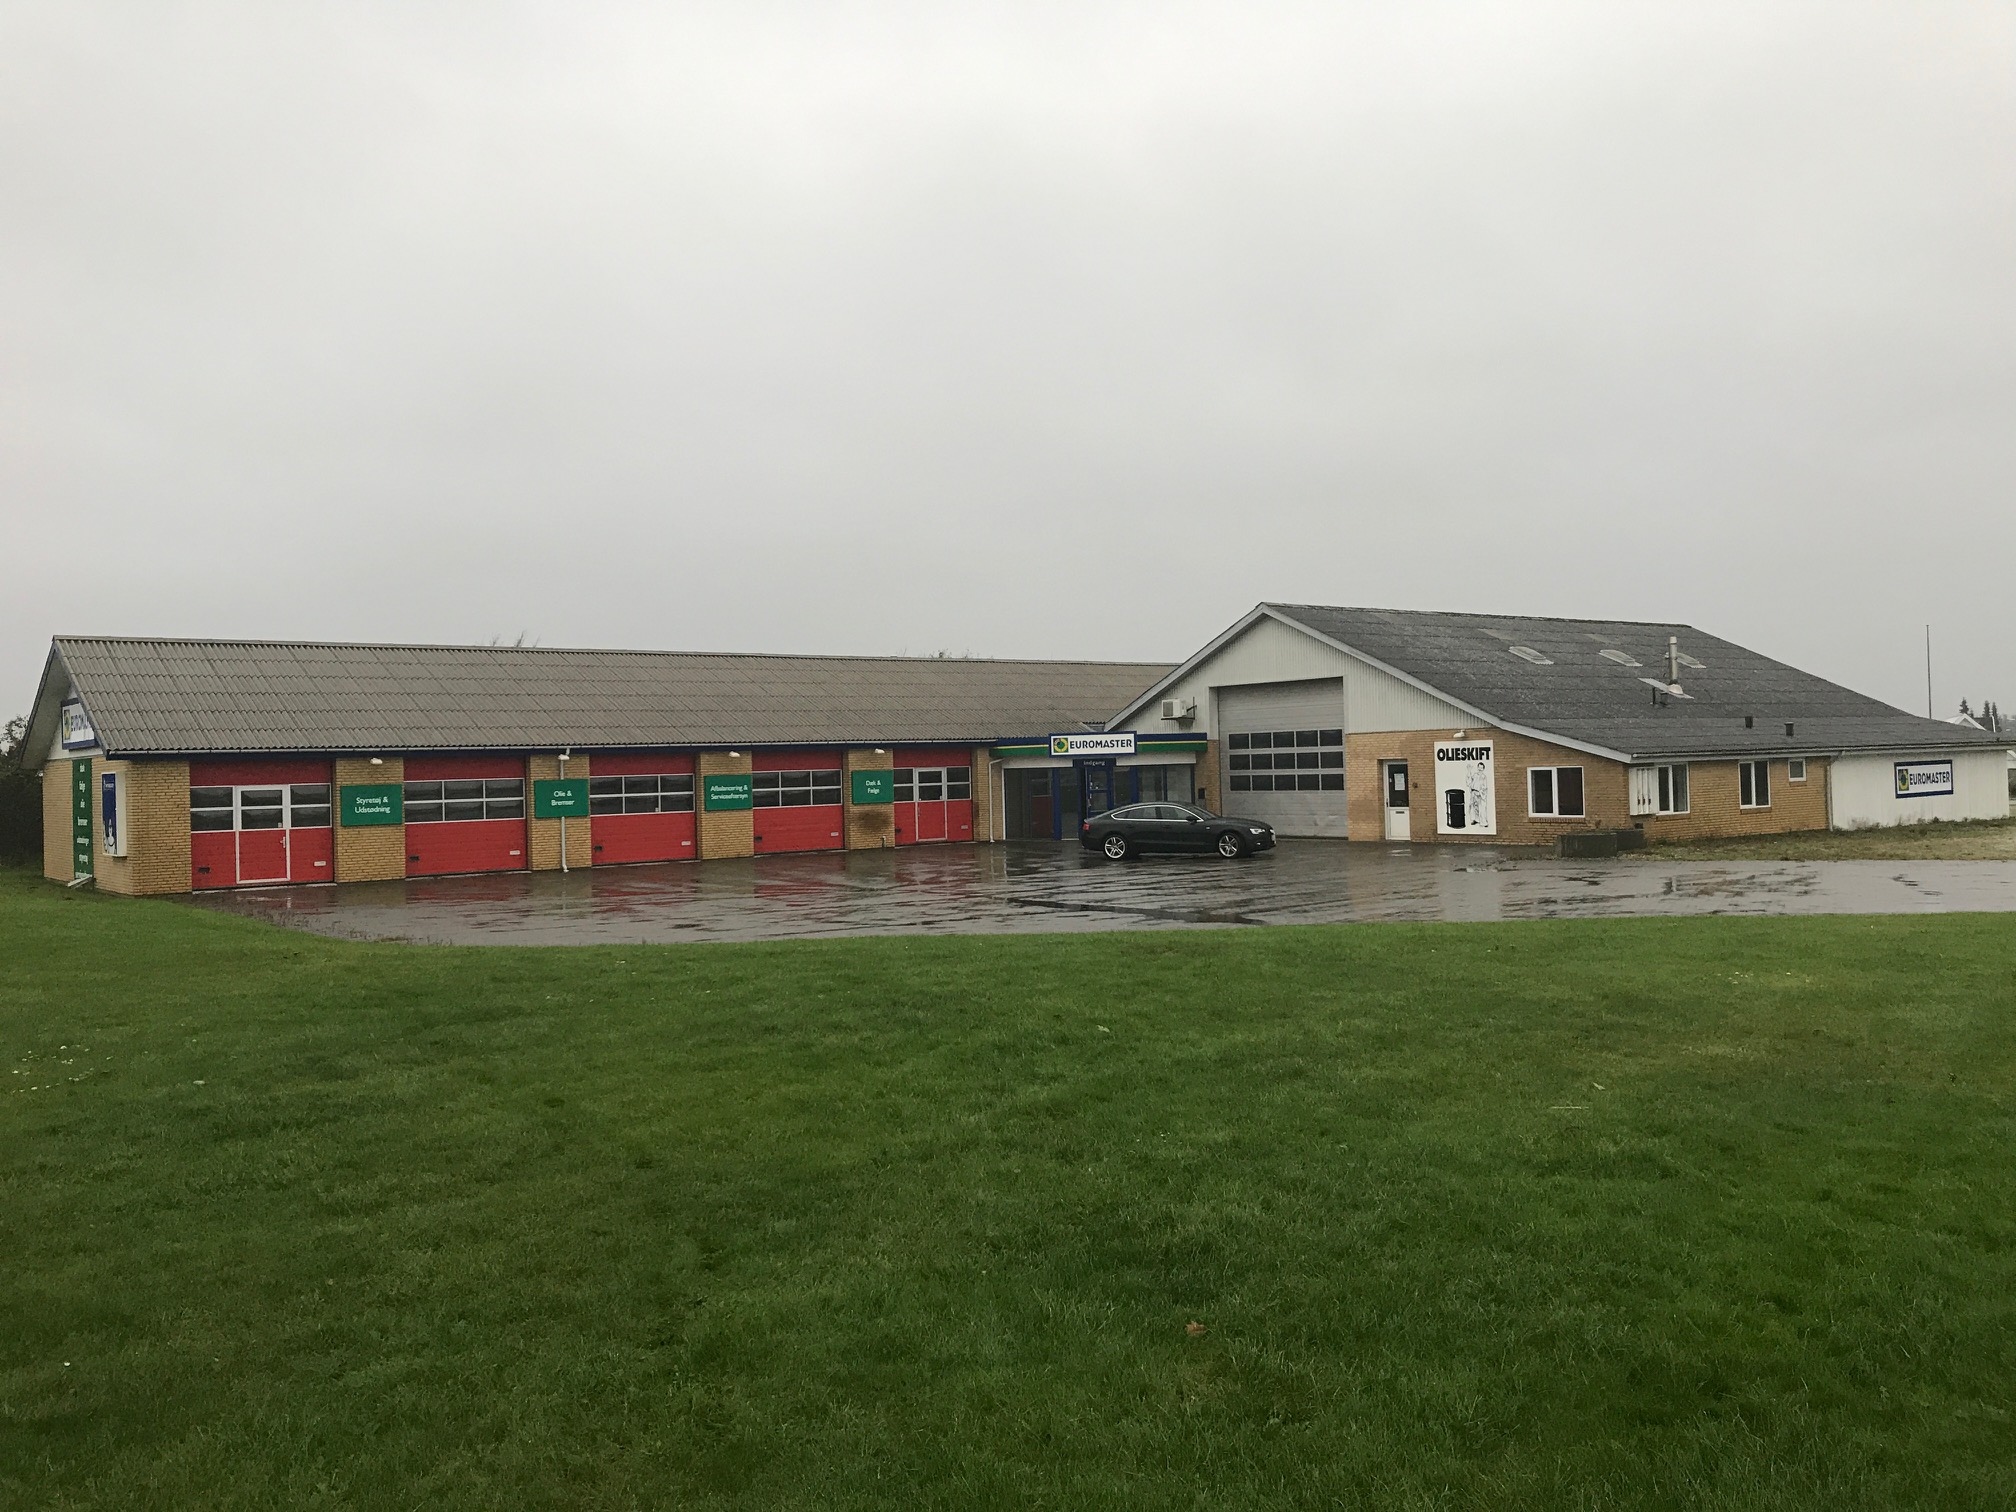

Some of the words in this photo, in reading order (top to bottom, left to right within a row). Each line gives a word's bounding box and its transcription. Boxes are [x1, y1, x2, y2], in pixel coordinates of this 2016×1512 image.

[1069, 738, 1132, 750] EUROMASTER
[1437, 746, 1491, 761] OLIESKIFT
[1909, 771, 1950, 785] EUROMASTER
[355, 796, 382, 805] Styretøj
[354, 806, 391, 814] Udstødning
